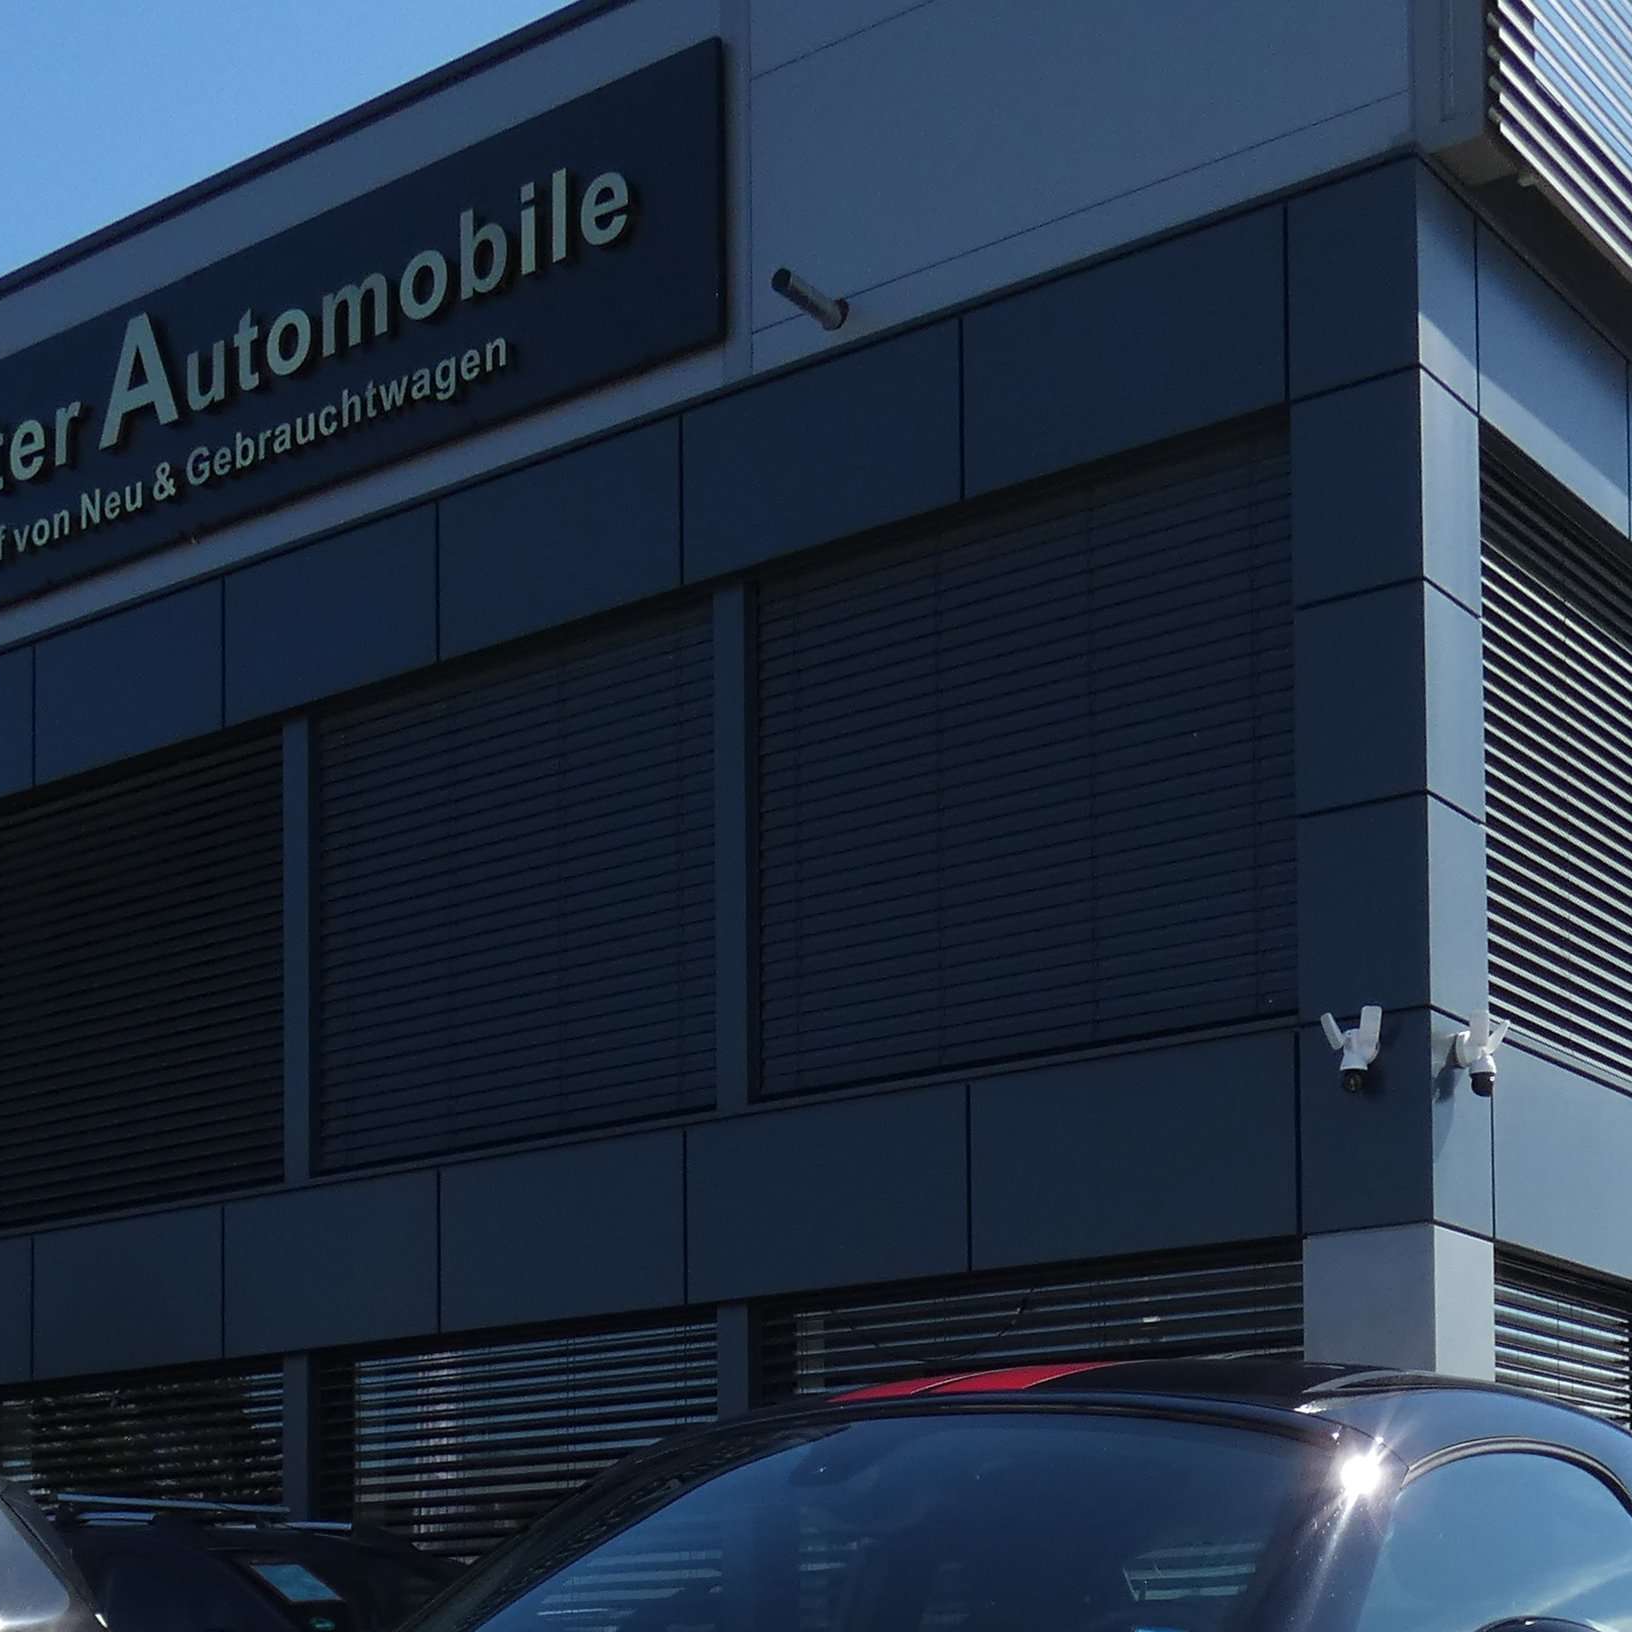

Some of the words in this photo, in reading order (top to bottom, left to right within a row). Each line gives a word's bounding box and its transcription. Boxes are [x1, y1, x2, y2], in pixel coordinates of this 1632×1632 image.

[98, 167, 628, 451] Automobile
[13, 507, 69, 553] von
[79, 480, 143, 530] Neu
[152, 461, 176, 500] &
[186, 337, 508, 487] Gebrauchtwagen
